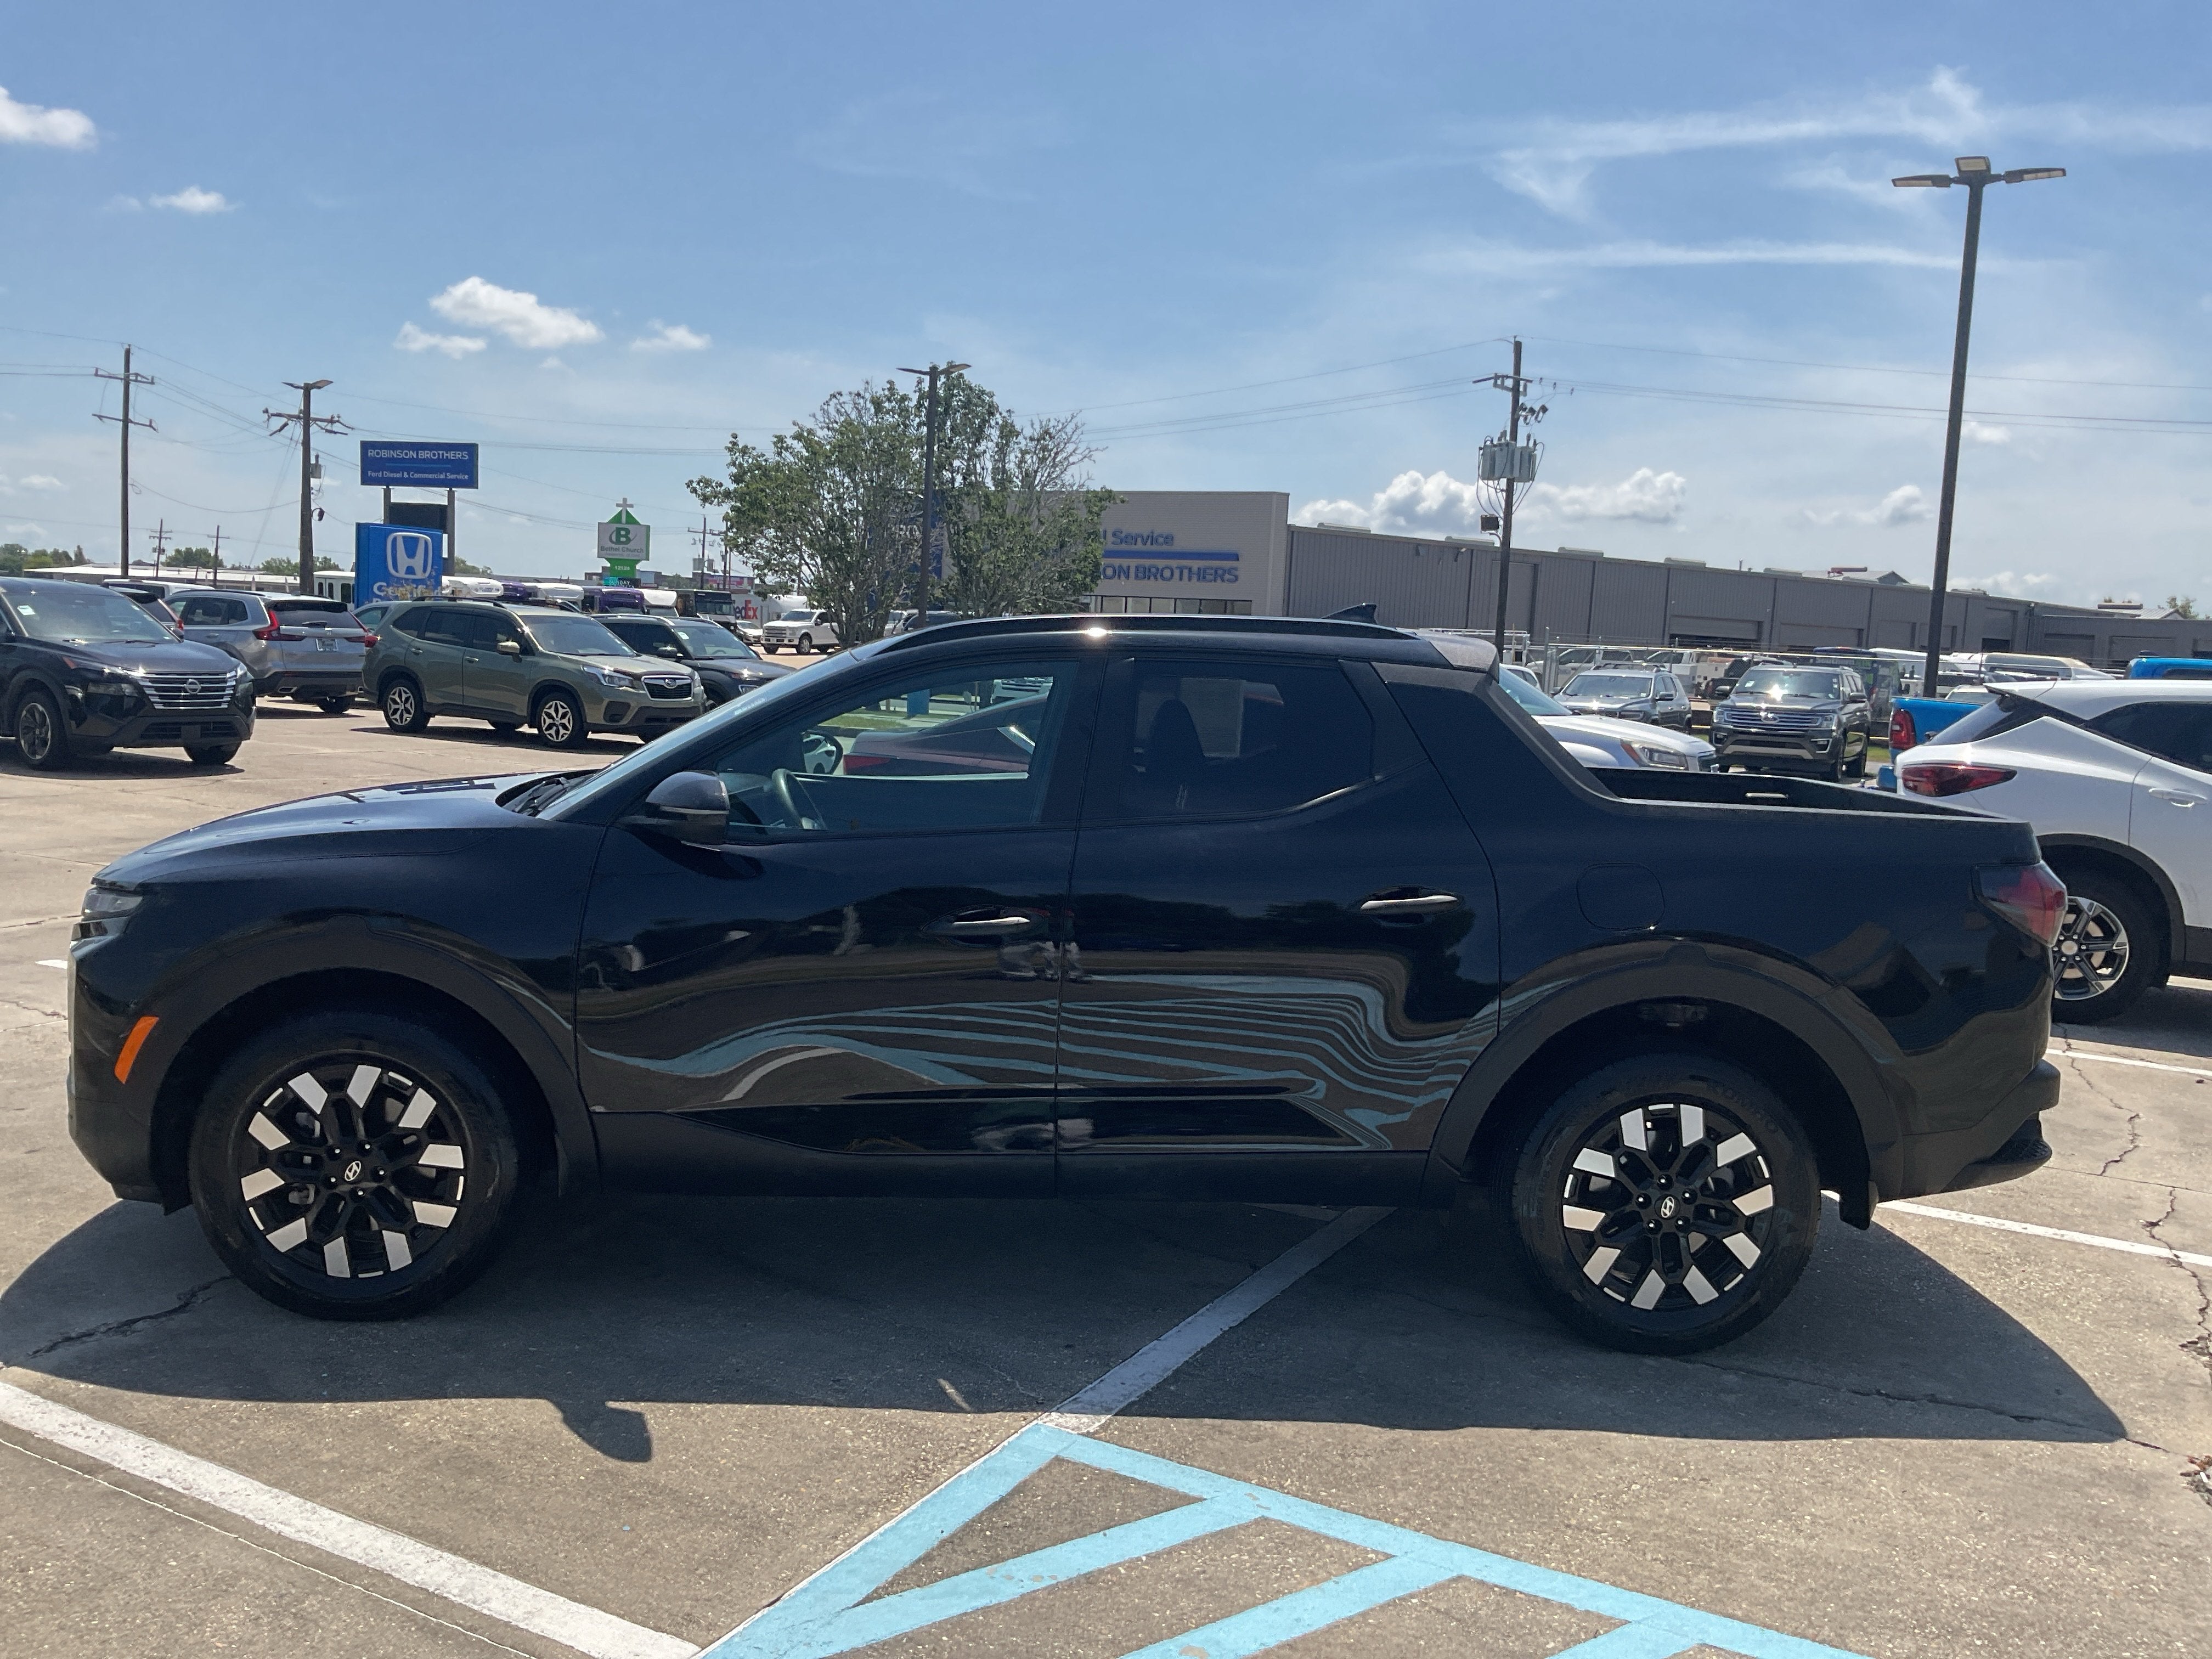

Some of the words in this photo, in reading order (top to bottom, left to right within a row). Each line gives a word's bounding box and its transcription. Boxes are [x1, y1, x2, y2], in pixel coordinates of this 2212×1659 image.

[368, 449, 416, 459] ROBINSON
[419, 450, 469, 460] BROTHERS
[616, 527, 632, 545] B
[1111, 529, 1175, 546] Service
[1134, 564, 1239, 583] BROTHERS
[735, 599, 758, 620] edEx
